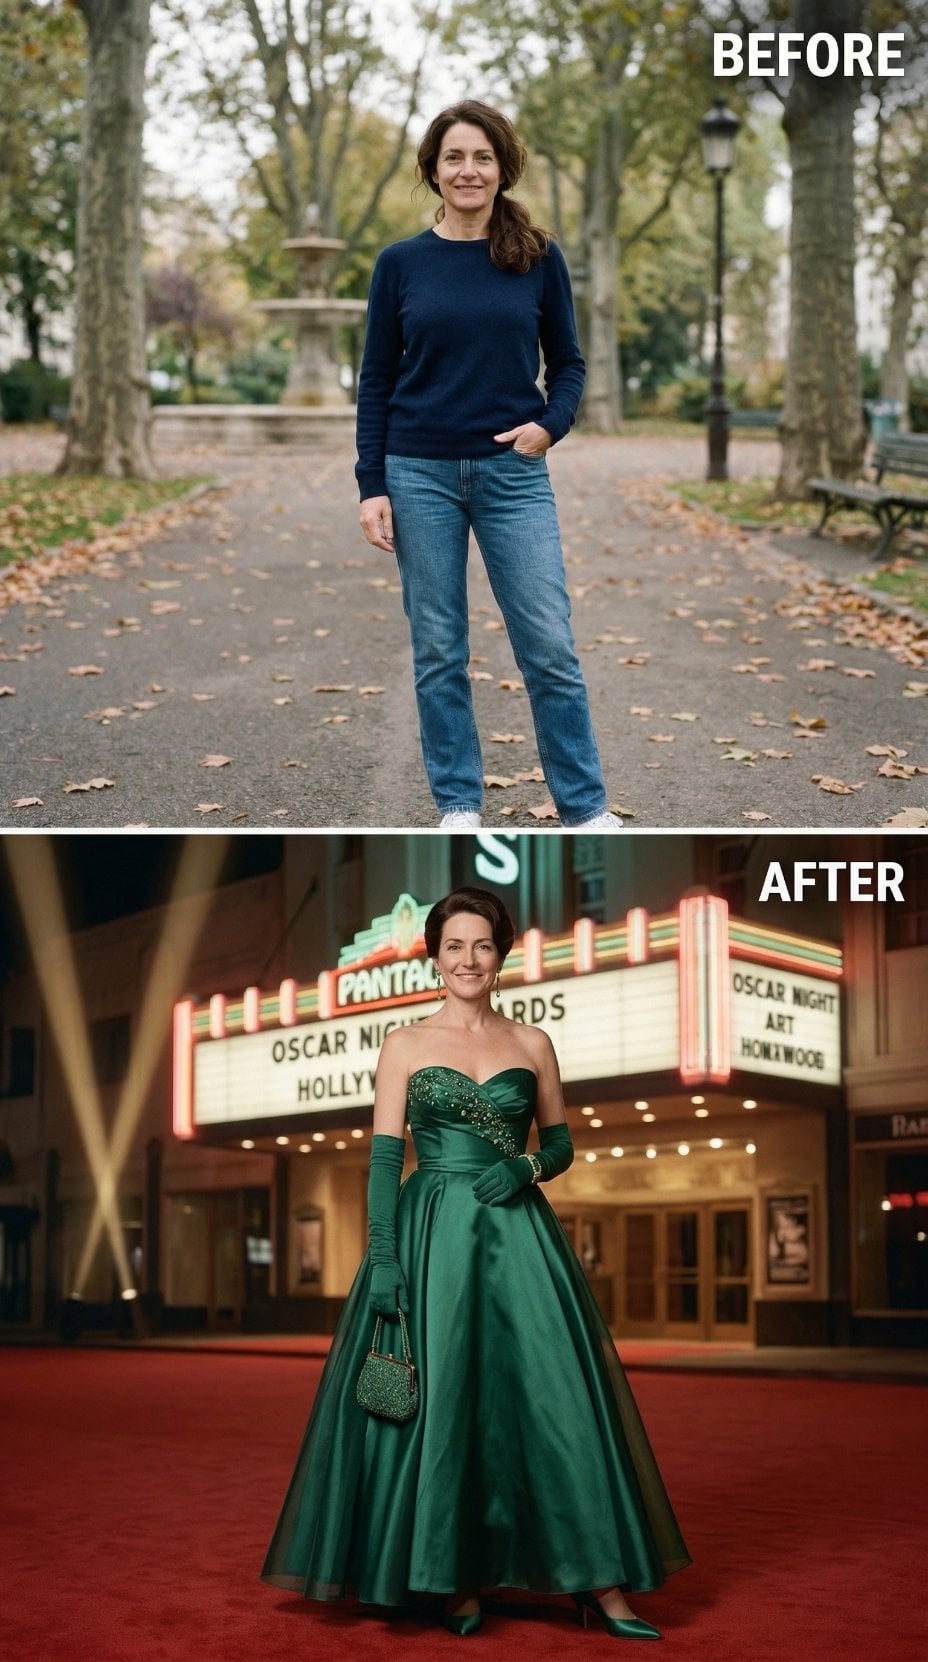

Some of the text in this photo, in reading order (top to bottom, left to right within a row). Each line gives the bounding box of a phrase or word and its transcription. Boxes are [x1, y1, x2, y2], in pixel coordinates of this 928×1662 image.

[733, 972, 837, 1014] OSCAR NIGHT
[766, 1011, 794, 1035] ART
[272, 1030, 347, 1063] OSCAR
